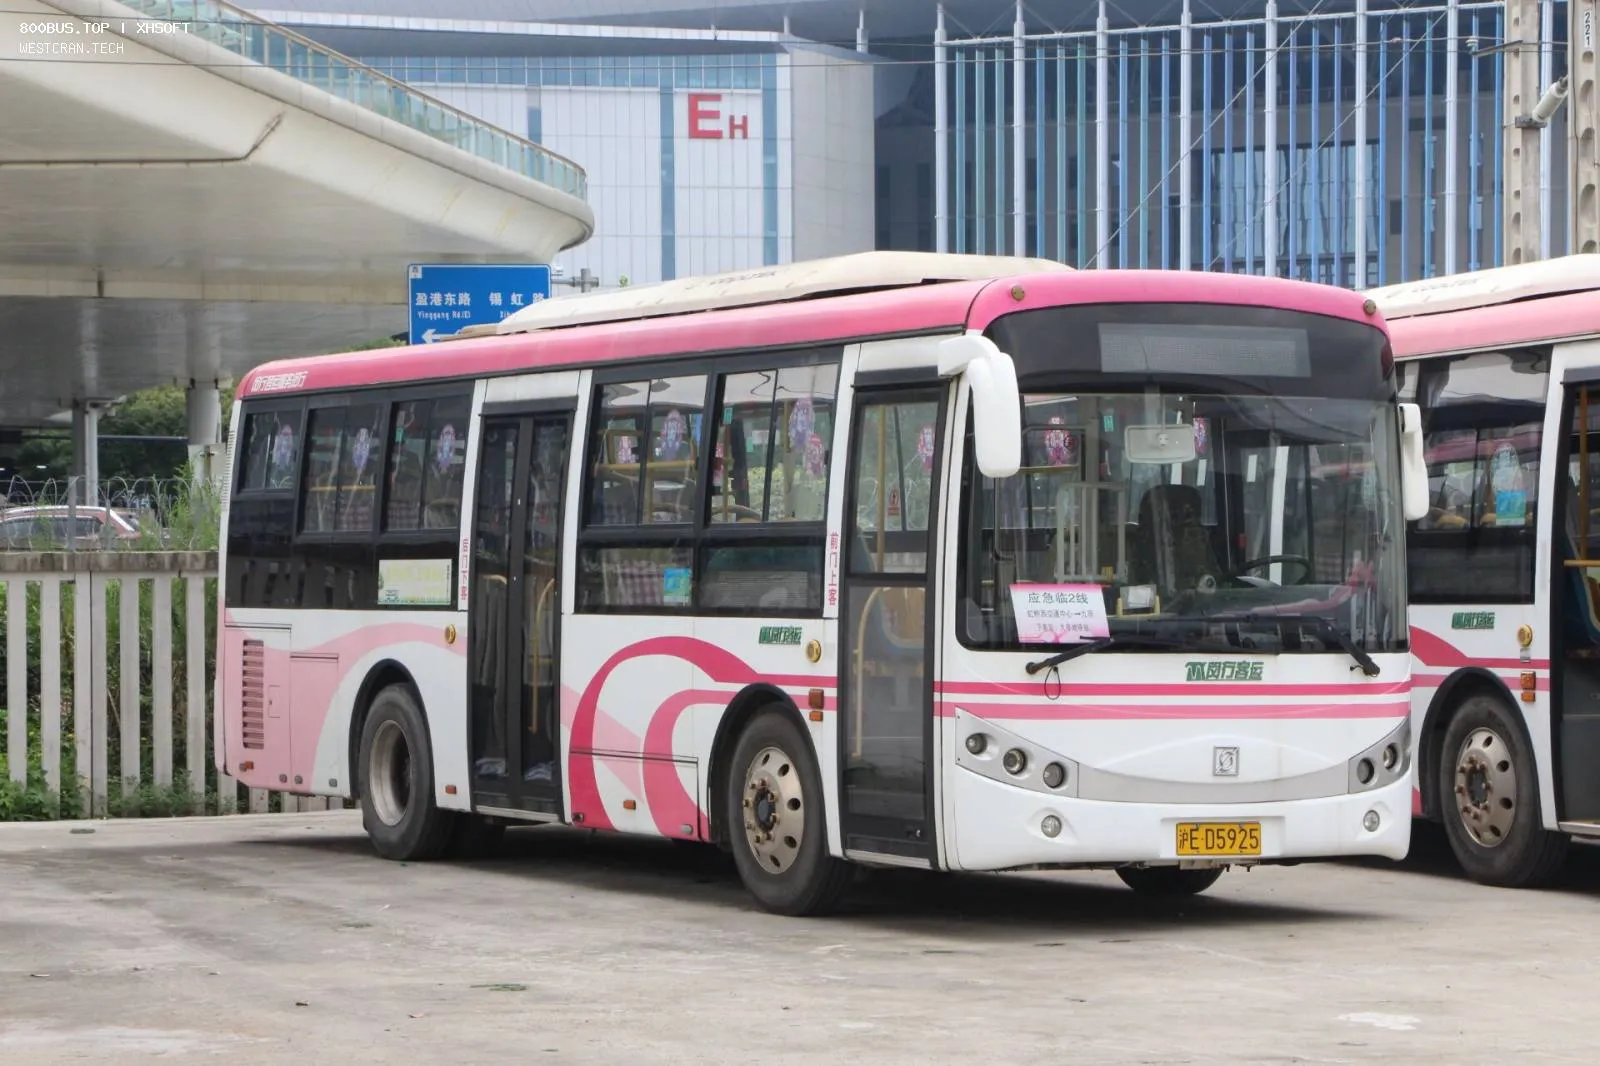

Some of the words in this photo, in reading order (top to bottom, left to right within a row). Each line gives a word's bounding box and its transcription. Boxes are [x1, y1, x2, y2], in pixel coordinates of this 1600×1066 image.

[415, 292, 471, 306] 盈港东路
[488, 291, 545, 306] 锡虹路
[828, 531, 839, 606] 前门上客
[1028, 592, 1088, 604] 应急临2线
[1205, 660, 1264, 681] 闵行客运
